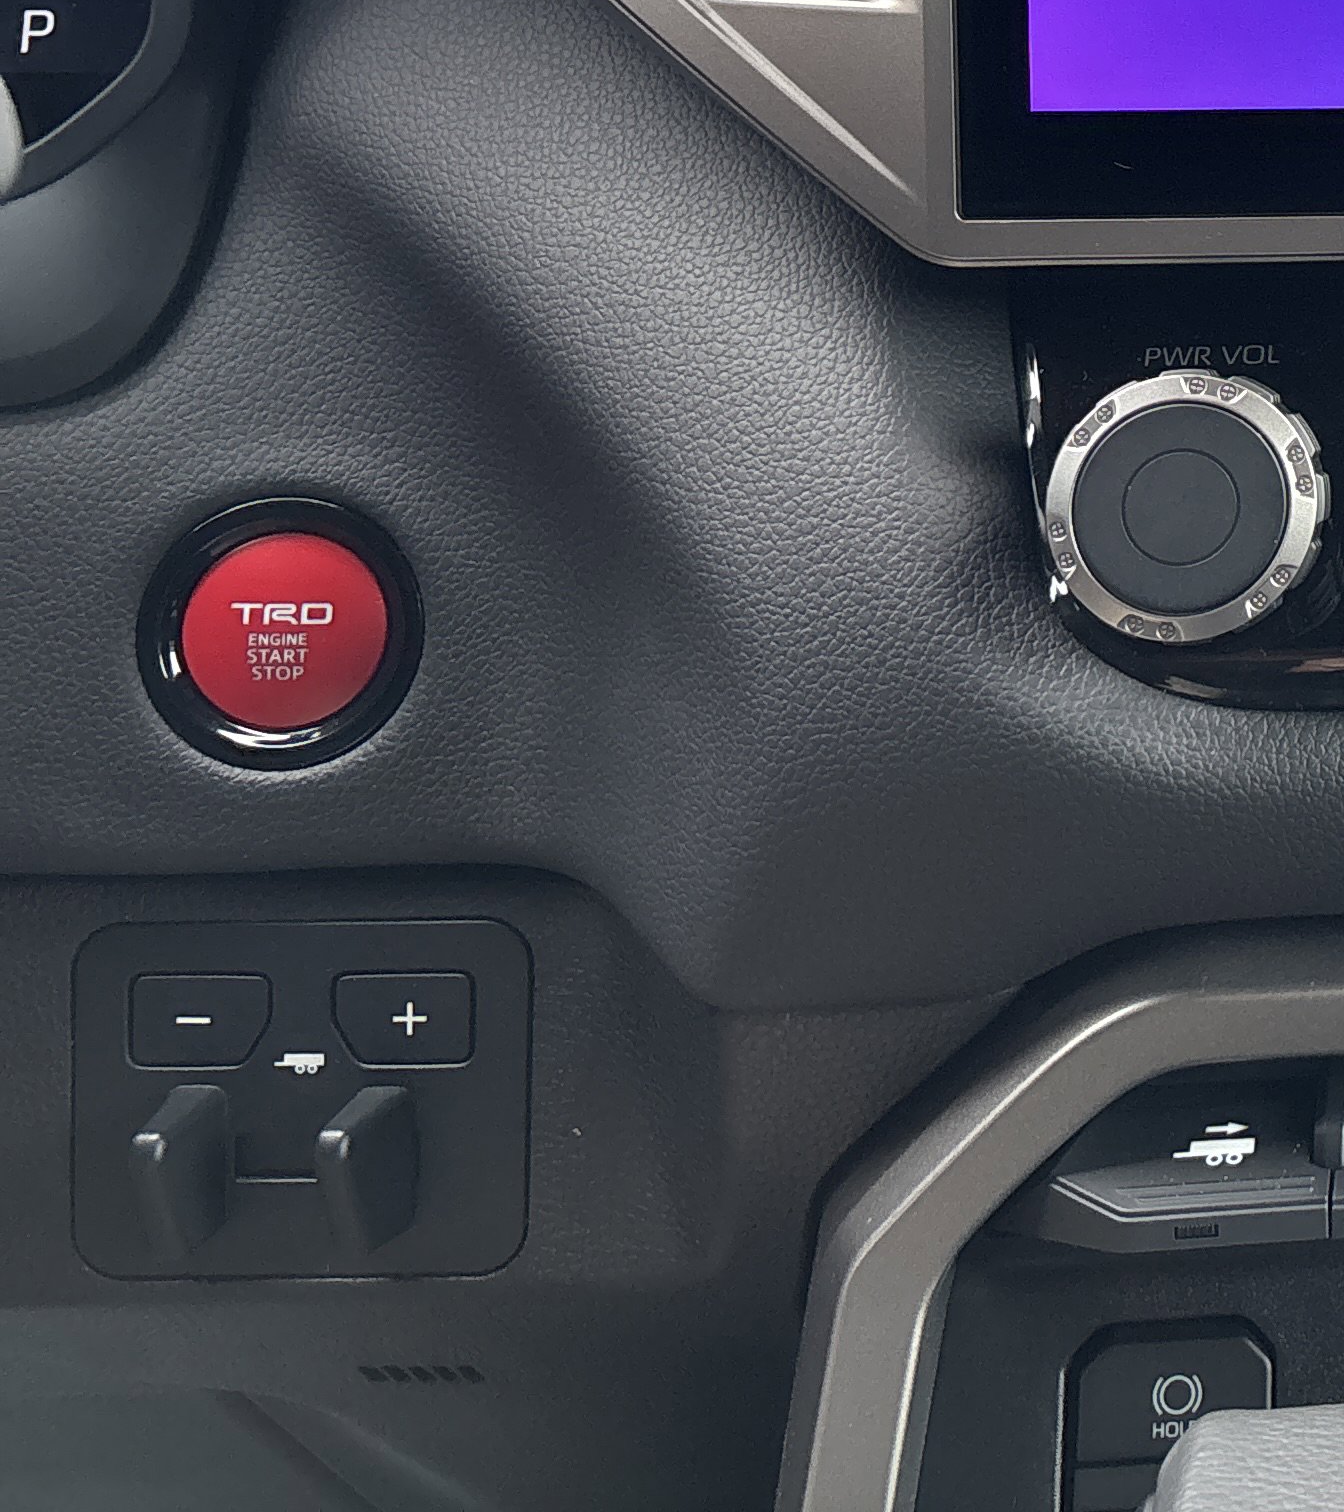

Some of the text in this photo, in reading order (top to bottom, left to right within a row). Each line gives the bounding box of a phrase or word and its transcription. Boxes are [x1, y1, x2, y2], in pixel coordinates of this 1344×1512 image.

[19, 9, 55, 54] P
[1144, 344, 1280, 366] PWR VOL
[231, 602, 334, 625] TRD
[247, 633, 308, 647] ENGINE
[246, 648, 309, 664] START
[251, 665, 304, 681] STOP
[1152, 1420, 1191, 1439] HO
